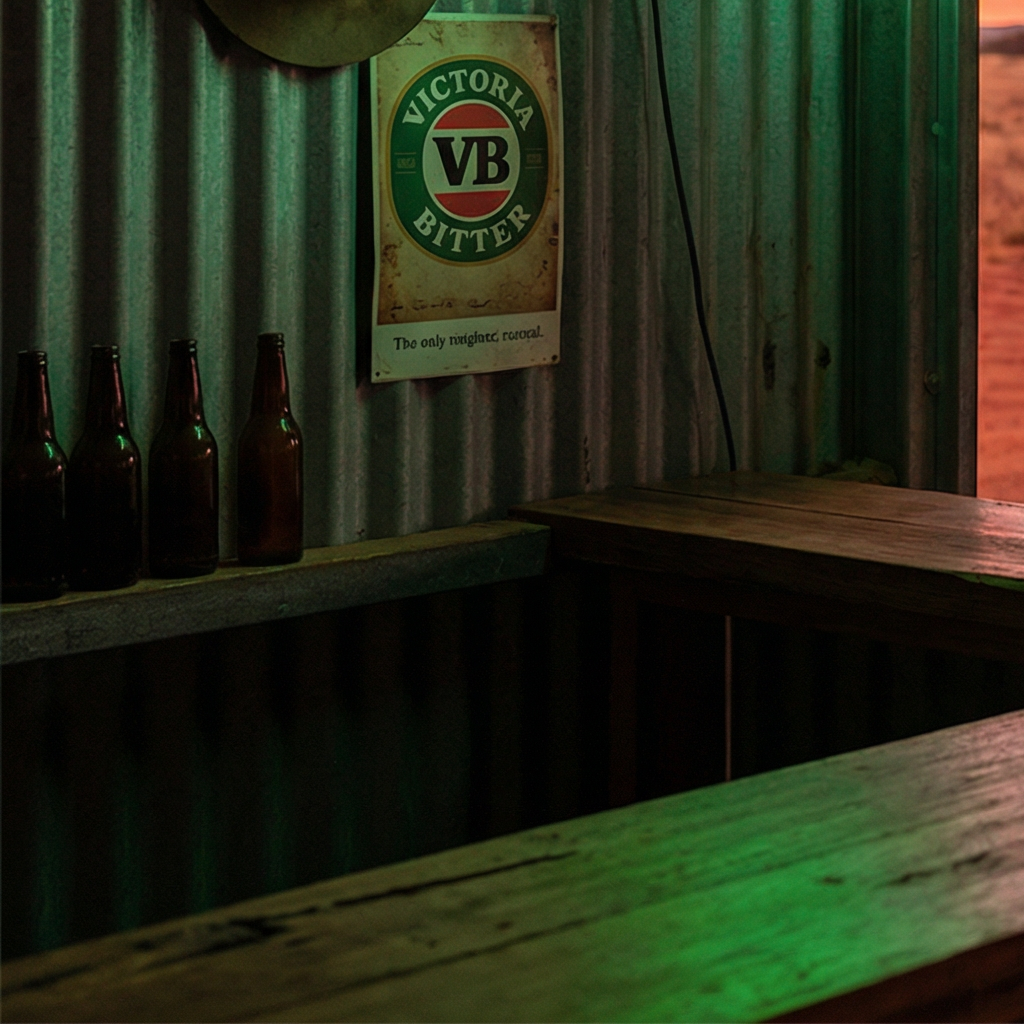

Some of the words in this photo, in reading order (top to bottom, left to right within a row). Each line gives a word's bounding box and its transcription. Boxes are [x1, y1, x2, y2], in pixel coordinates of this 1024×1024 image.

[402, 68, 536, 131] VICTORIA
[432, 135, 511, 187] VB
[413, 203, 532, 254] BITTER
[420, 334, 446, 350] only
